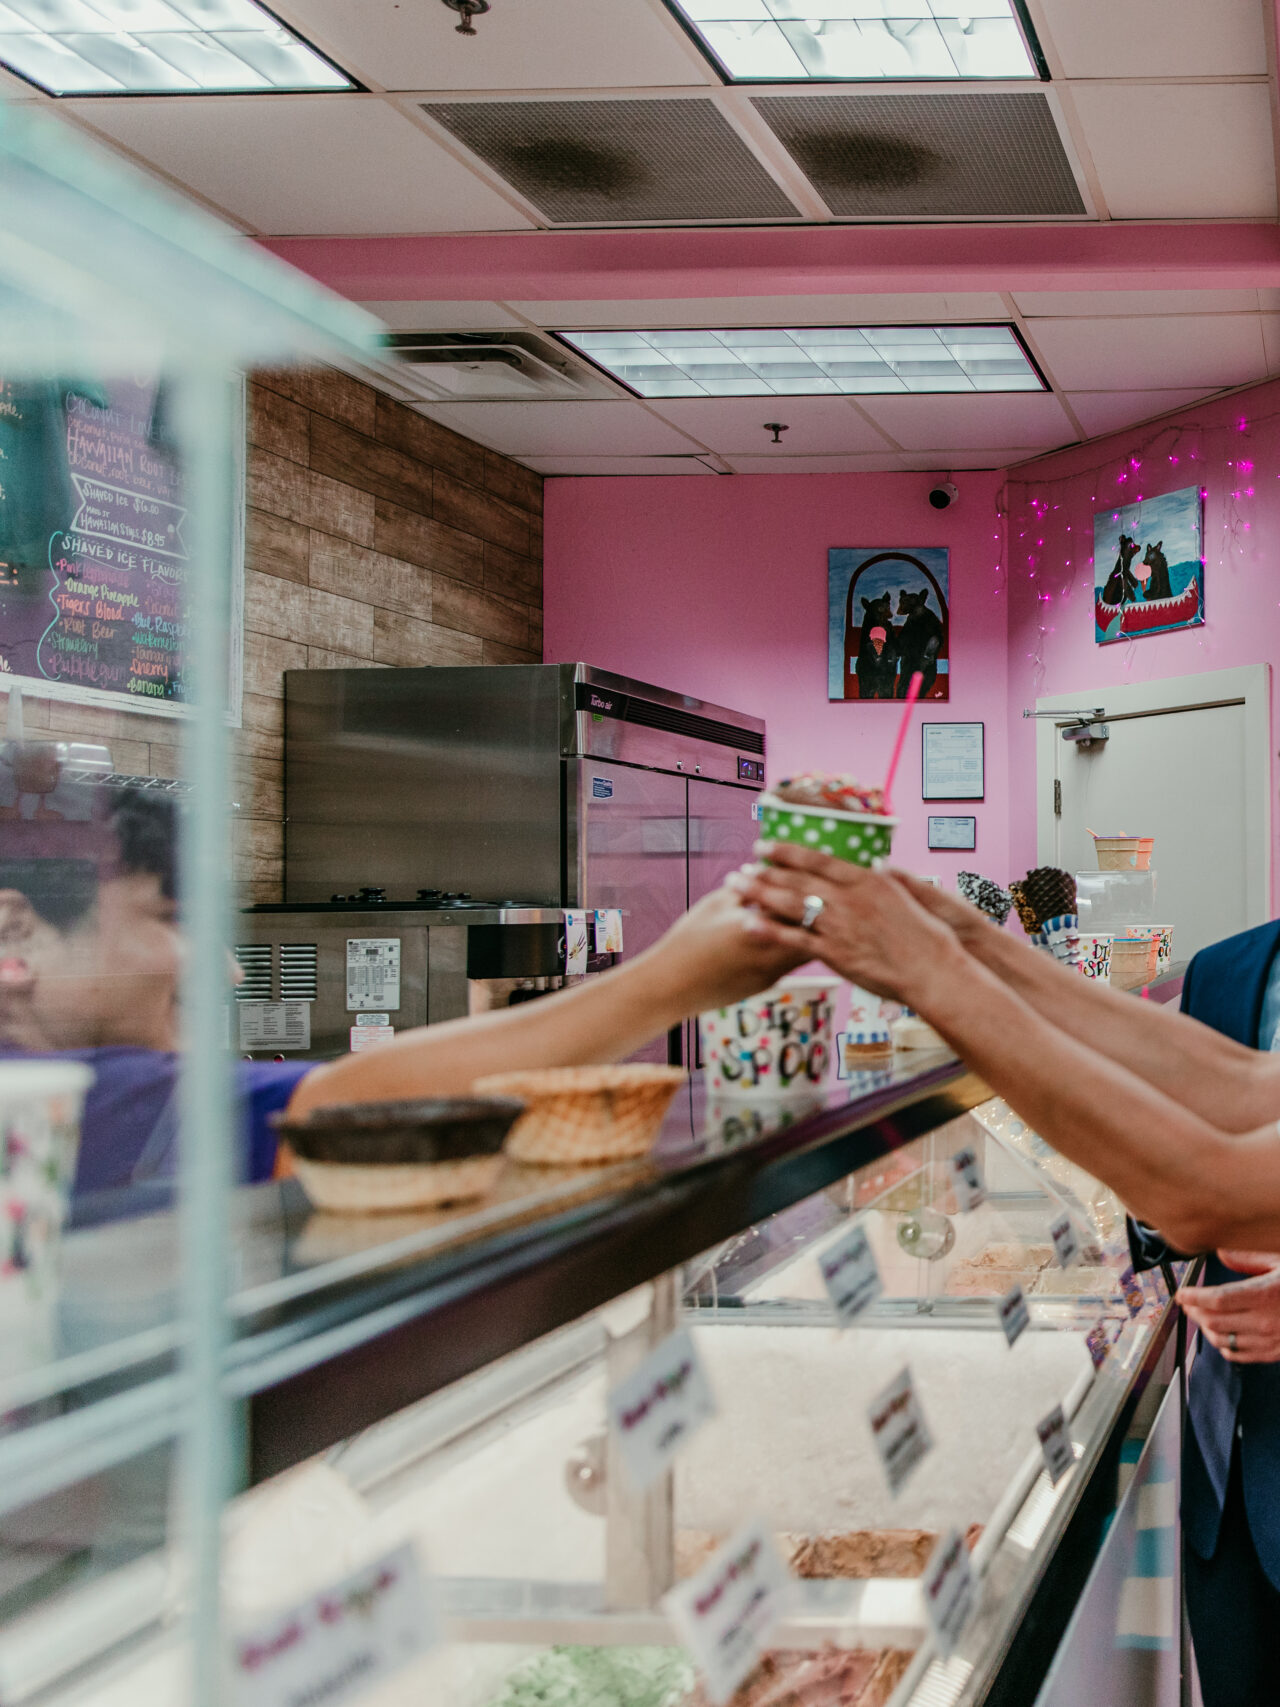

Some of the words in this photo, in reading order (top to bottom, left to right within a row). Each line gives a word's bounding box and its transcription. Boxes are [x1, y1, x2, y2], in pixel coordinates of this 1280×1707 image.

[67, 425, 133, 473] HAWAIIAN
[82, 482, 113, 502] SHAVED
[116, 493, 129, 507] ICE
[141, 528, 166, 547] $8.95
[62, 535, 114, 560] SHAVED
[118, 552, 137, 568] ICE
[67, 577, 99, 600] Orange
[101, 584, 139, 608] Pineapple
[96, 601, 124, 620] Blood
[132, 658, 168, 684] Cherry
[130, 677, 165, 698] Banana
